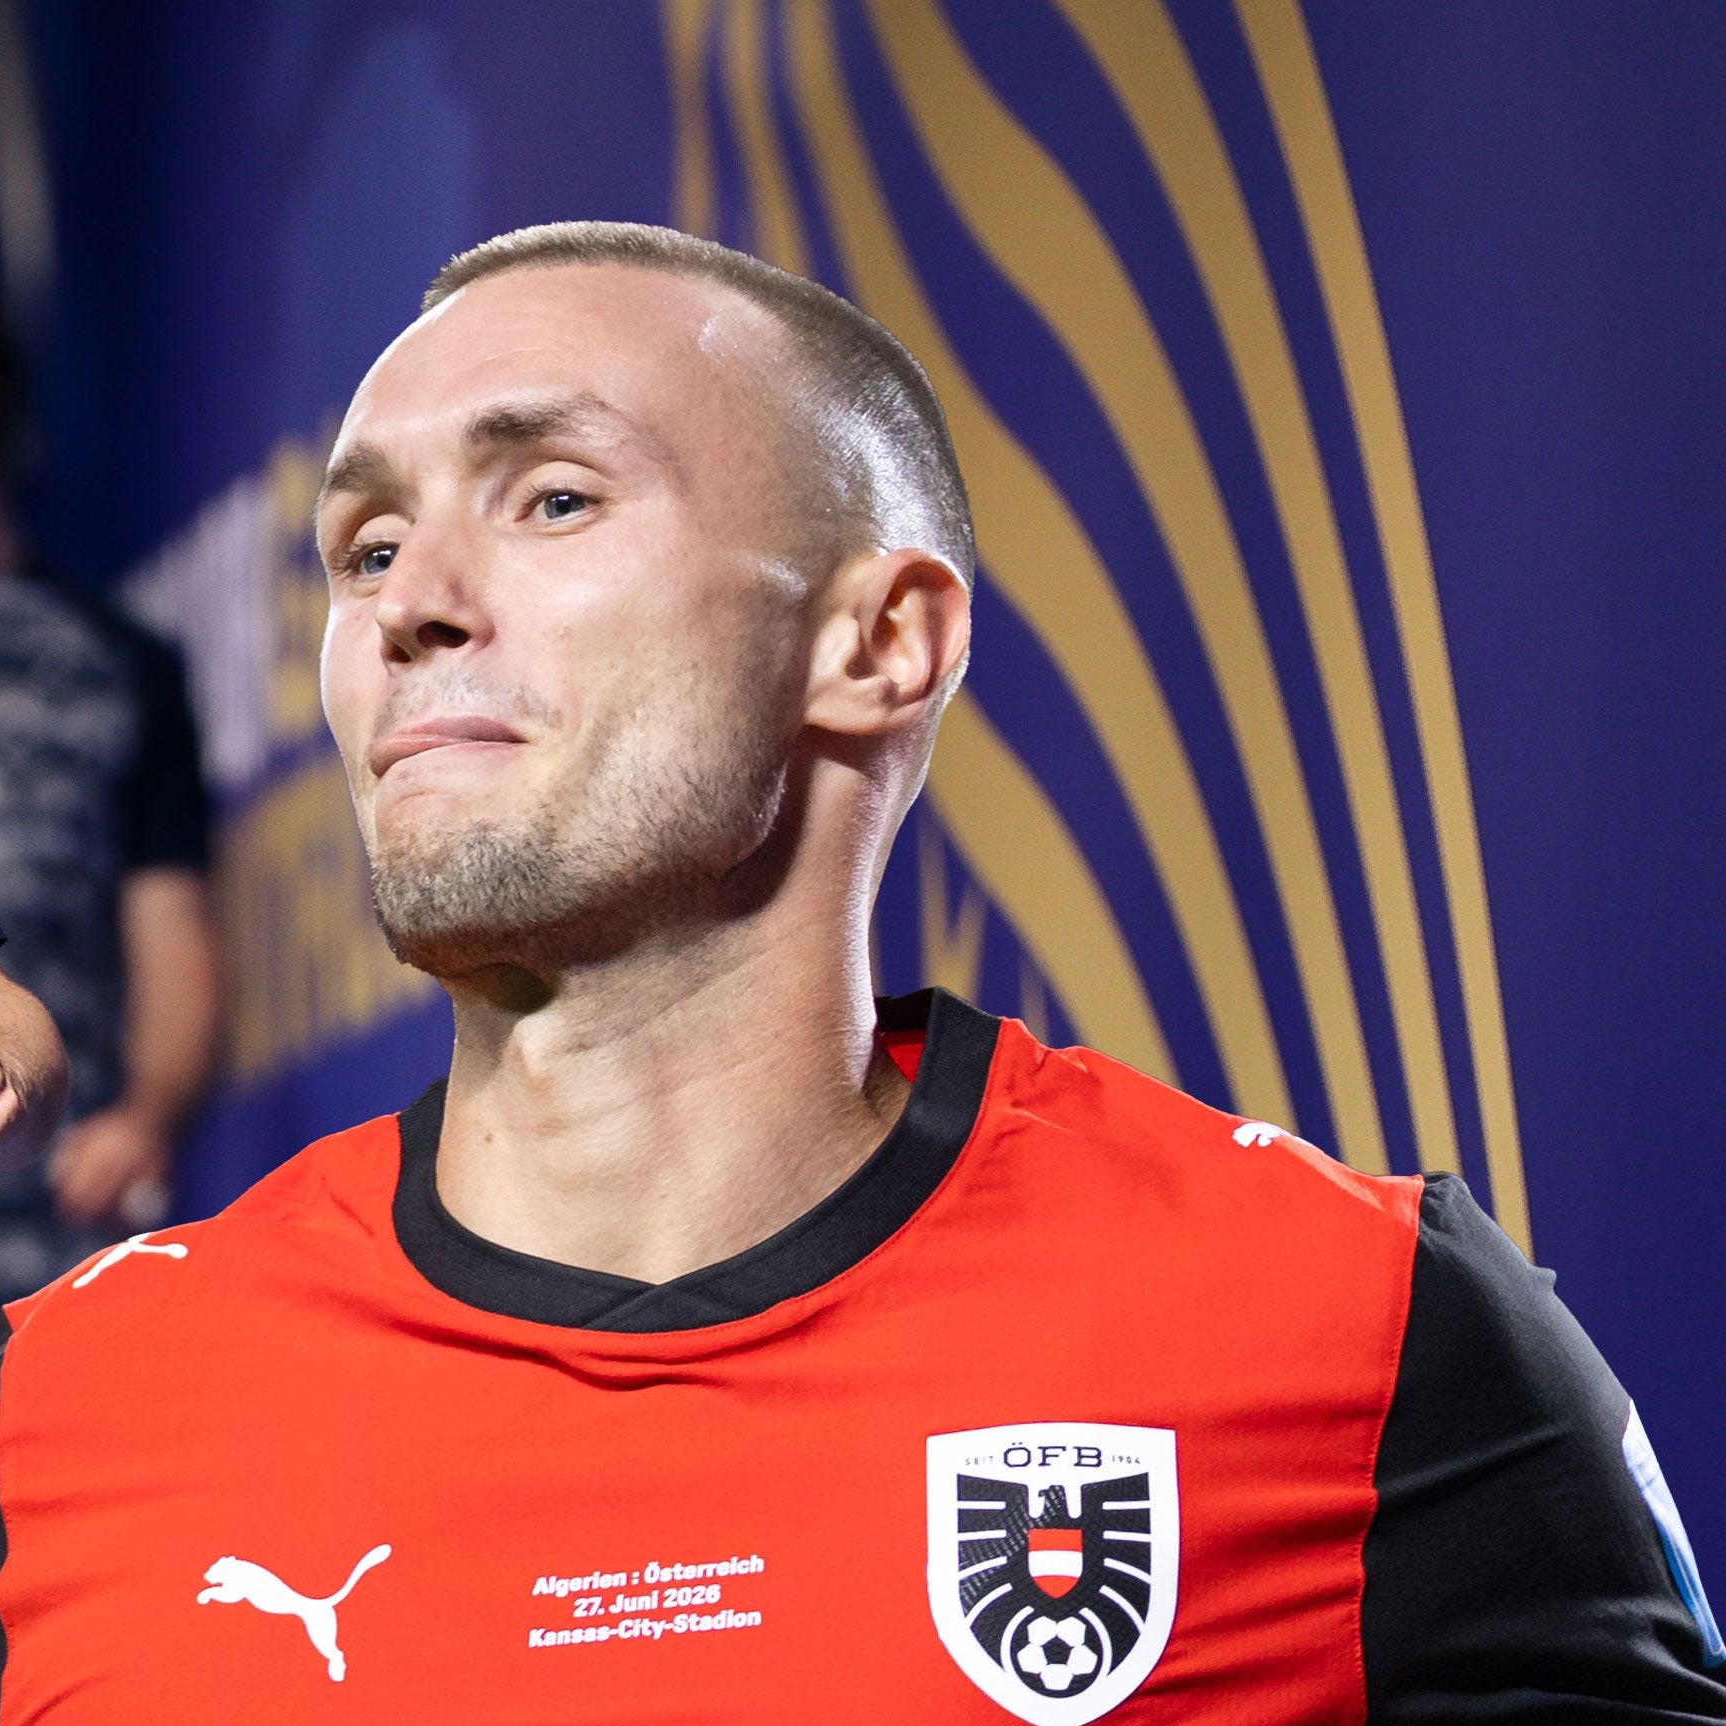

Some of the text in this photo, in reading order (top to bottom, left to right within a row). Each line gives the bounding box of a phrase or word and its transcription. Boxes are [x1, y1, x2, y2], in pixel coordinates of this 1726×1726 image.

[1003, 1442, 1102, 1468] ÖFB
[531, 1571, 627, 1597] Algerien
[643, 1554, 765, 1585] Österreich
[572, 1583, 721, 1618] 27. Juni 2026
[527, 1608, 762, 1648] Kansas-City-Stadion
